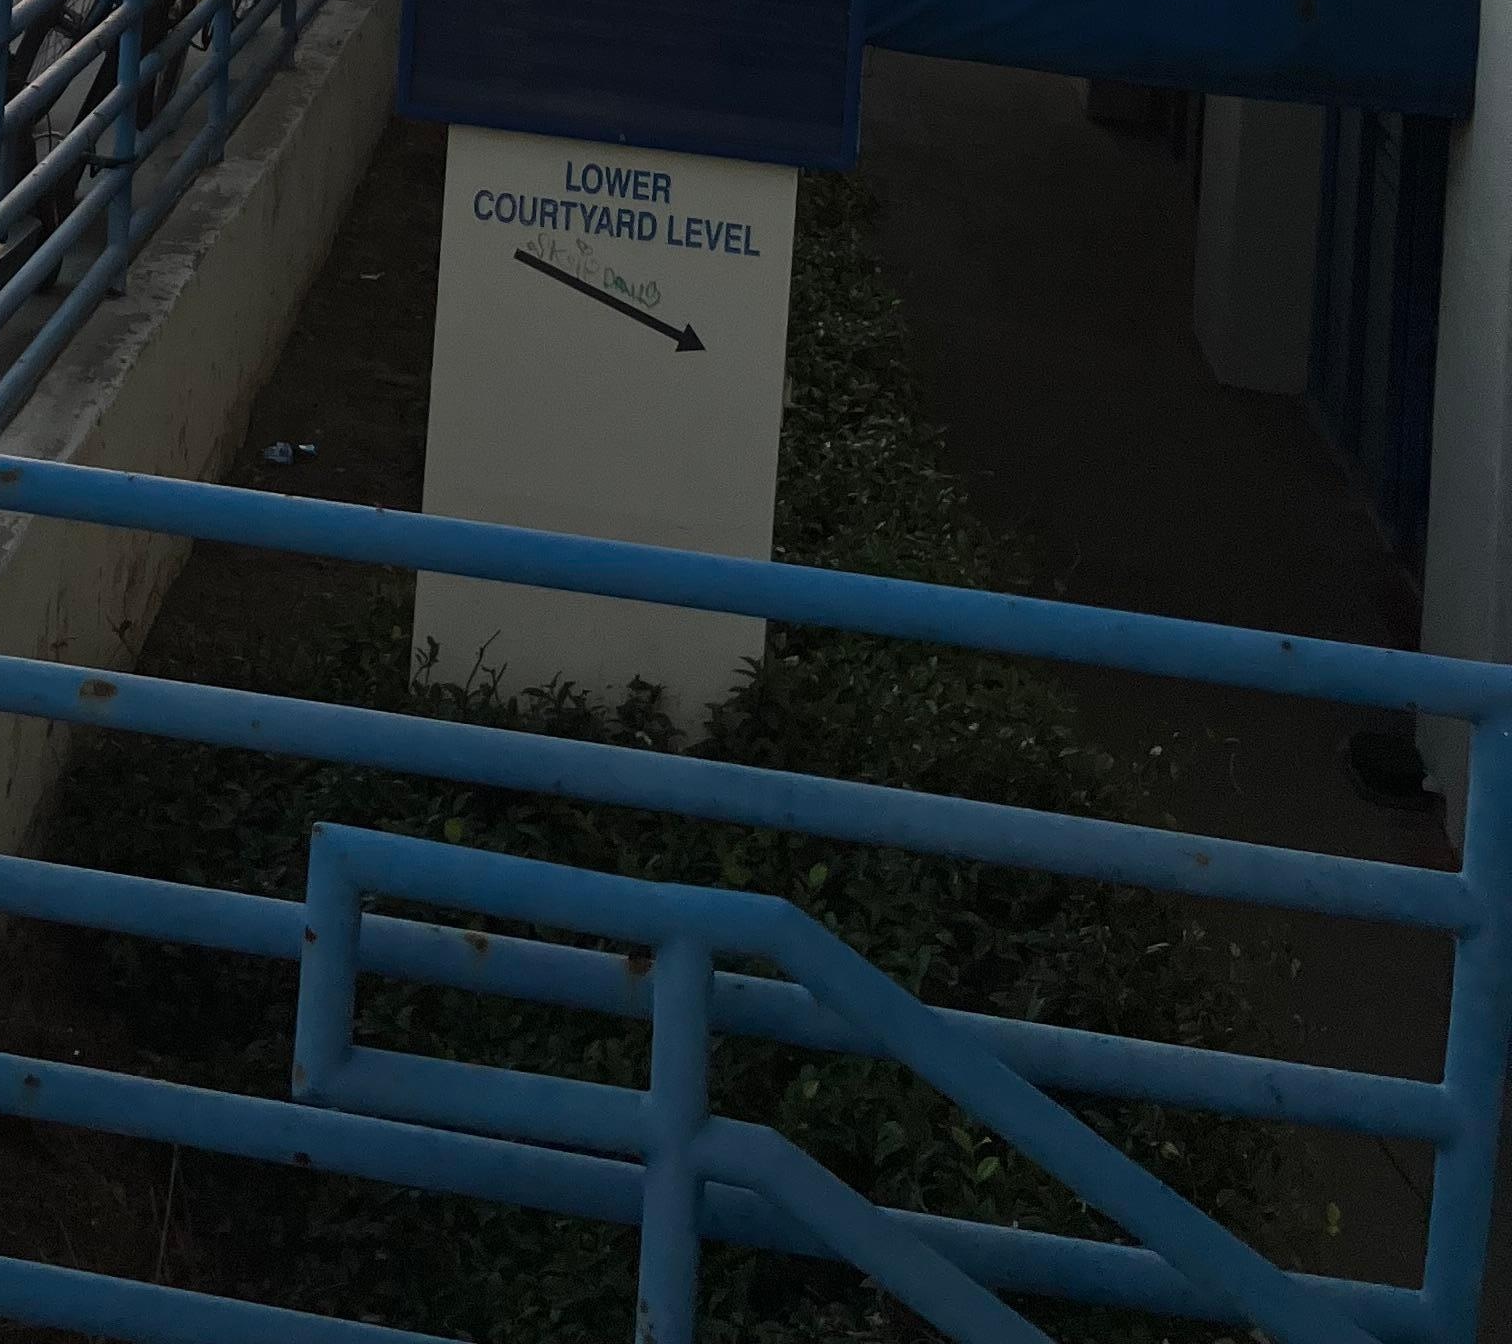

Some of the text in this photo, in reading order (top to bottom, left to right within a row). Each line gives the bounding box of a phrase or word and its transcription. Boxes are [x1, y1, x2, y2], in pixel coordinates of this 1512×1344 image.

[565, 160, 672, 205] LOWER
[473, 189, 761, 257] COURTYARD LEVEL
